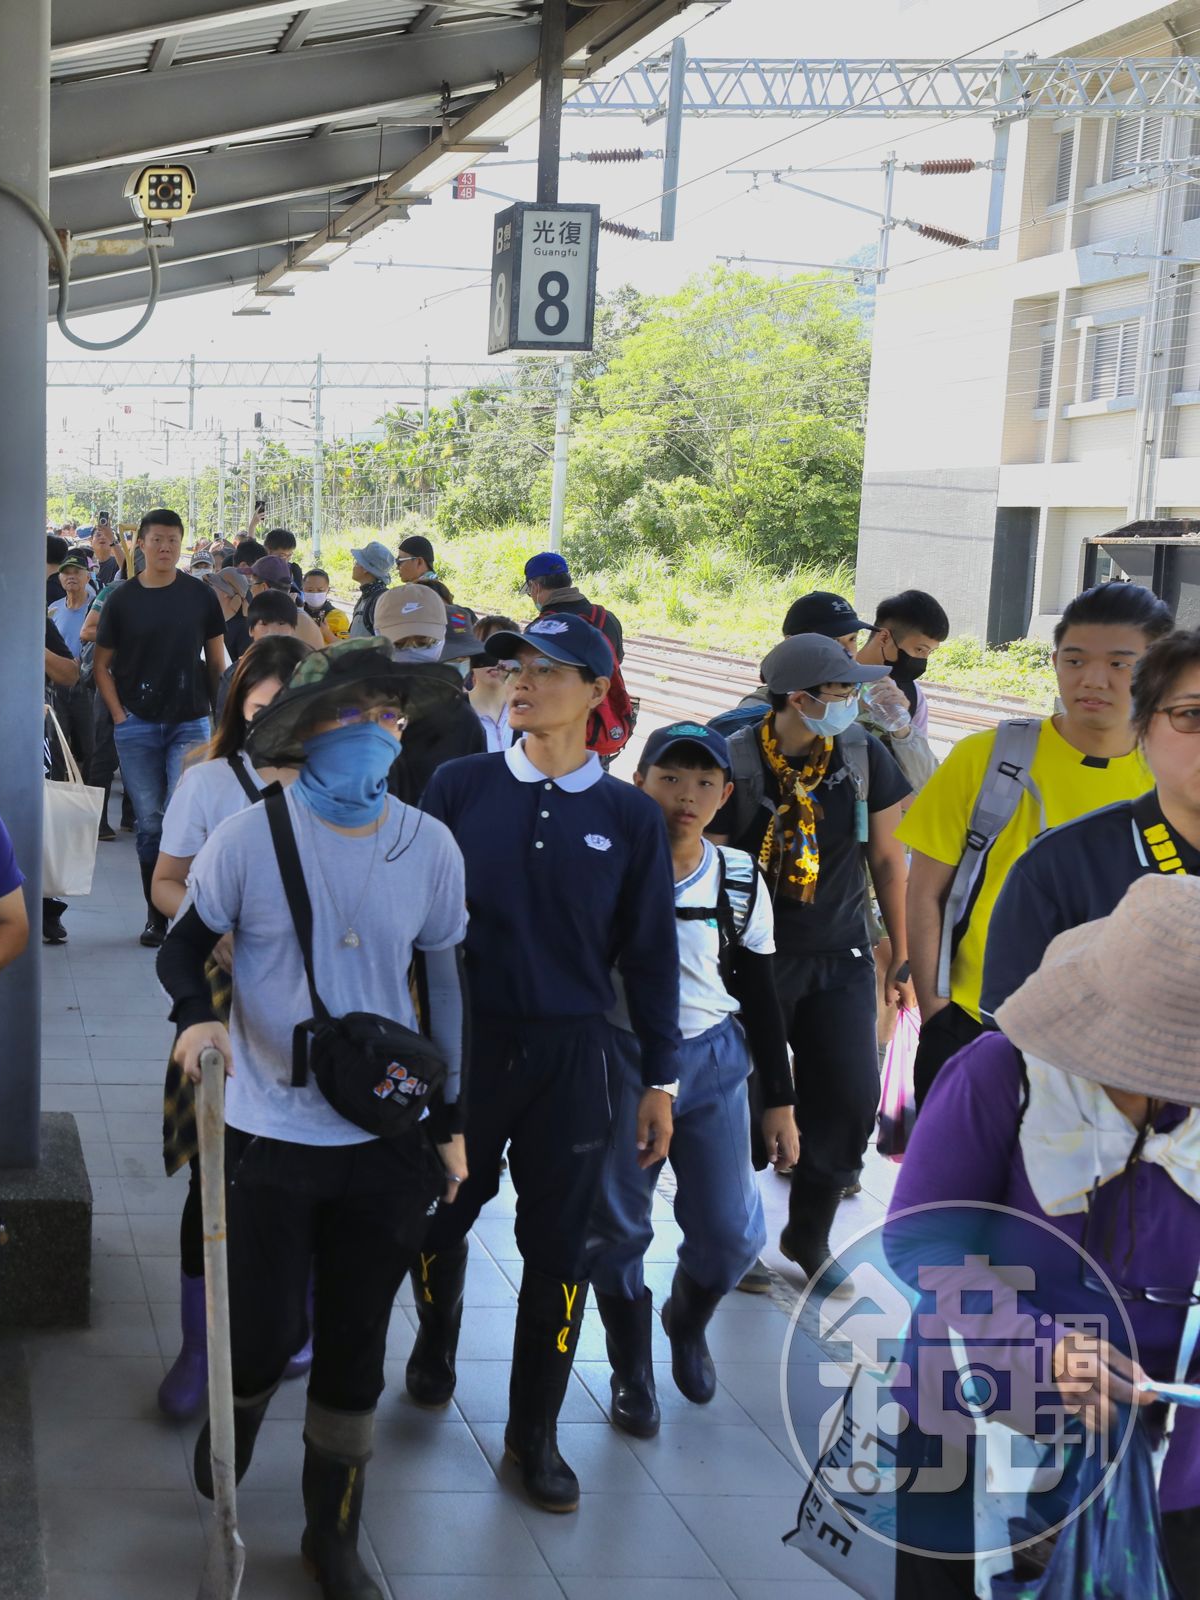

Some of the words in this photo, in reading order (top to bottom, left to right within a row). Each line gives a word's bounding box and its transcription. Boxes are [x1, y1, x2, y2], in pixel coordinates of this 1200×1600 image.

[461, 174, 473, 185] 43
[460, 187, 473, 199] 4B
[532, 219, 582, 245] 光復
[533, 247, 578, 258] Guangfu
[494, 272, 506, 337] 8
[534, 270, 570, 336] 8
[817, 1431, 897, 1558] LOVE
